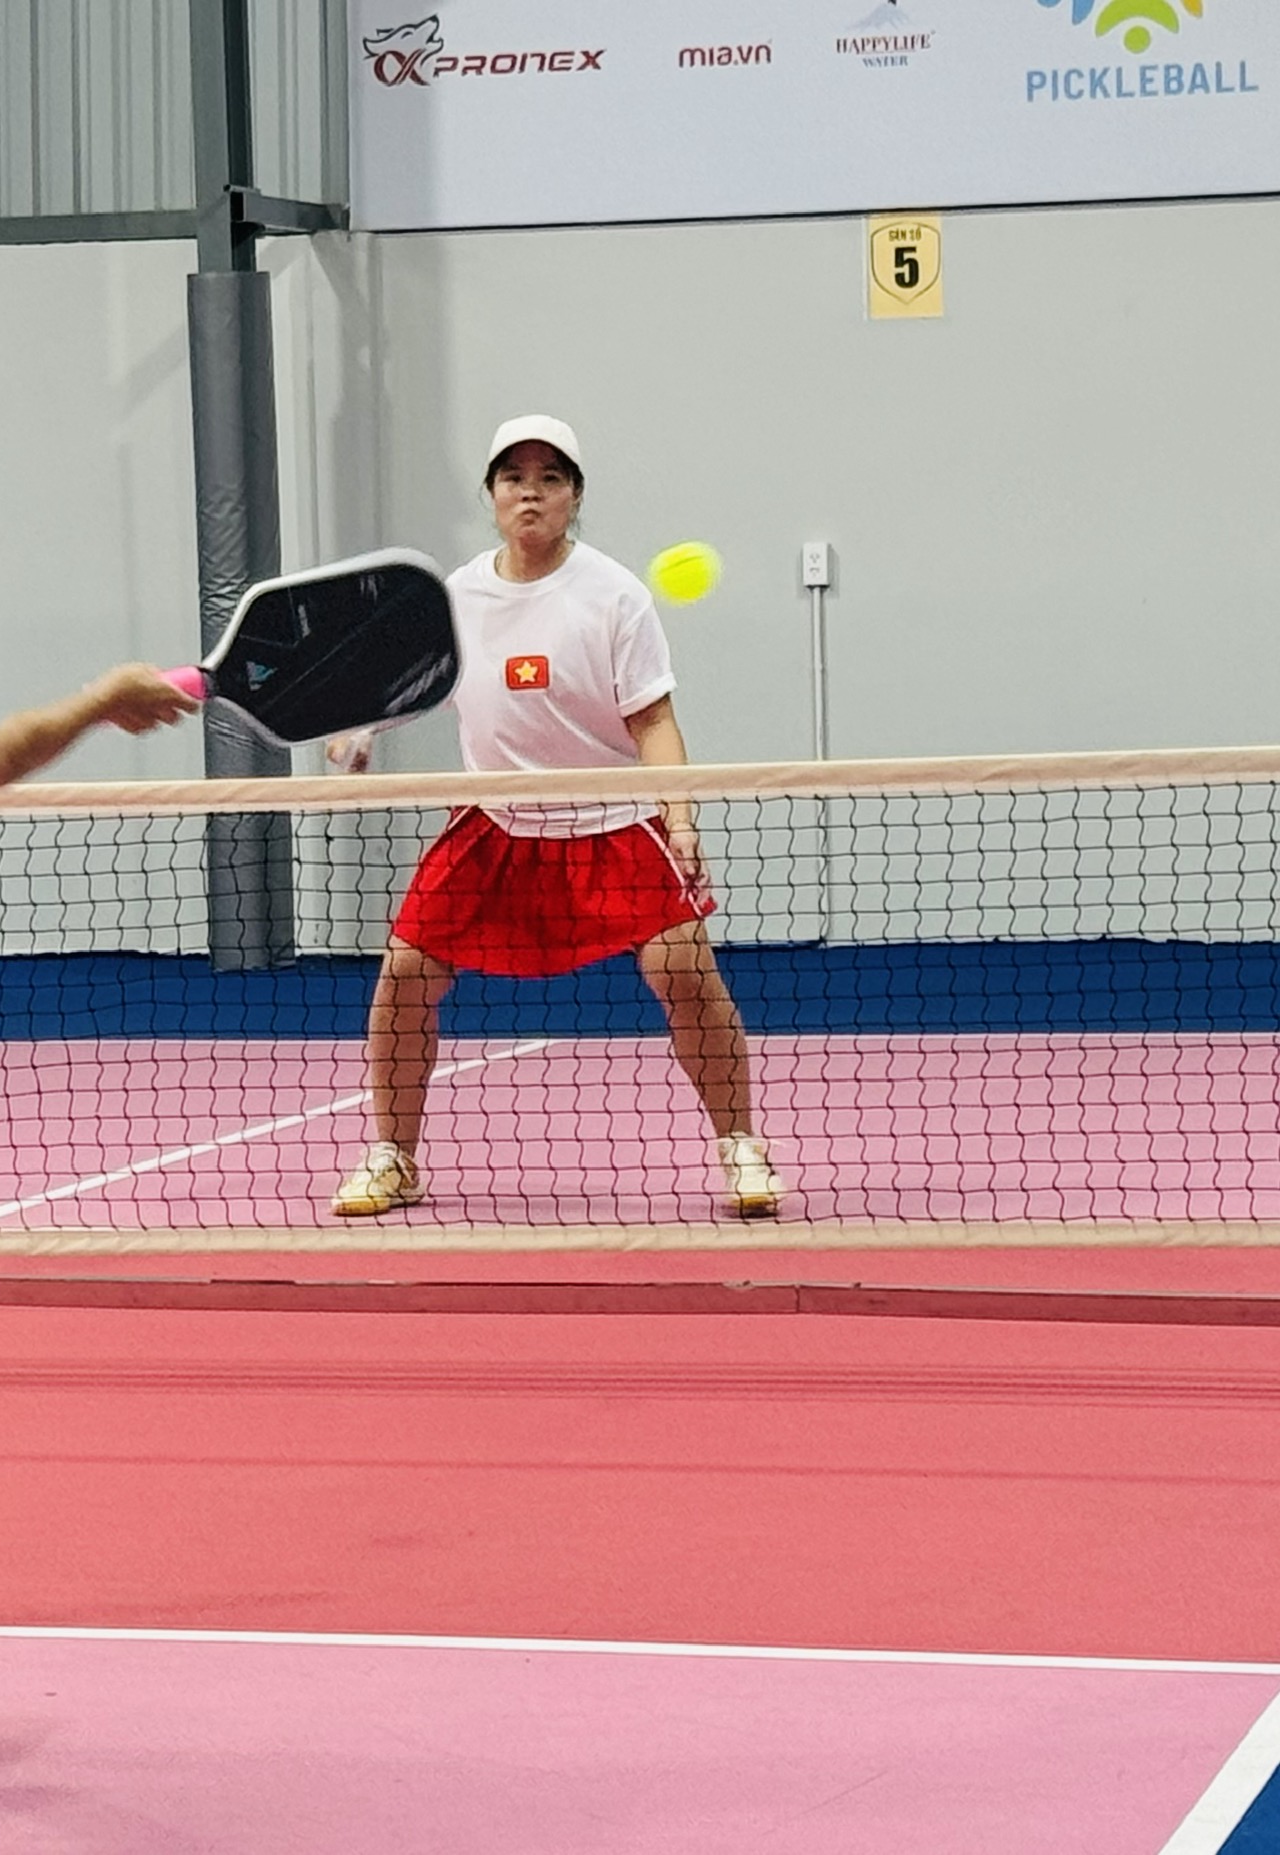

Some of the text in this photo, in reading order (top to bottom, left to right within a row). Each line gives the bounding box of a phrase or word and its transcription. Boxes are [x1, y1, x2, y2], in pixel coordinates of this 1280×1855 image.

[678, 44, 771, 68] mia.vn
[835, 34, 931, 54] HAPPYLIFE
[433, 49, 606, 78] PRONEX
[1025, 60, 1260, 103] PICKLEBALL
[894, 246, 919, 289] 5
